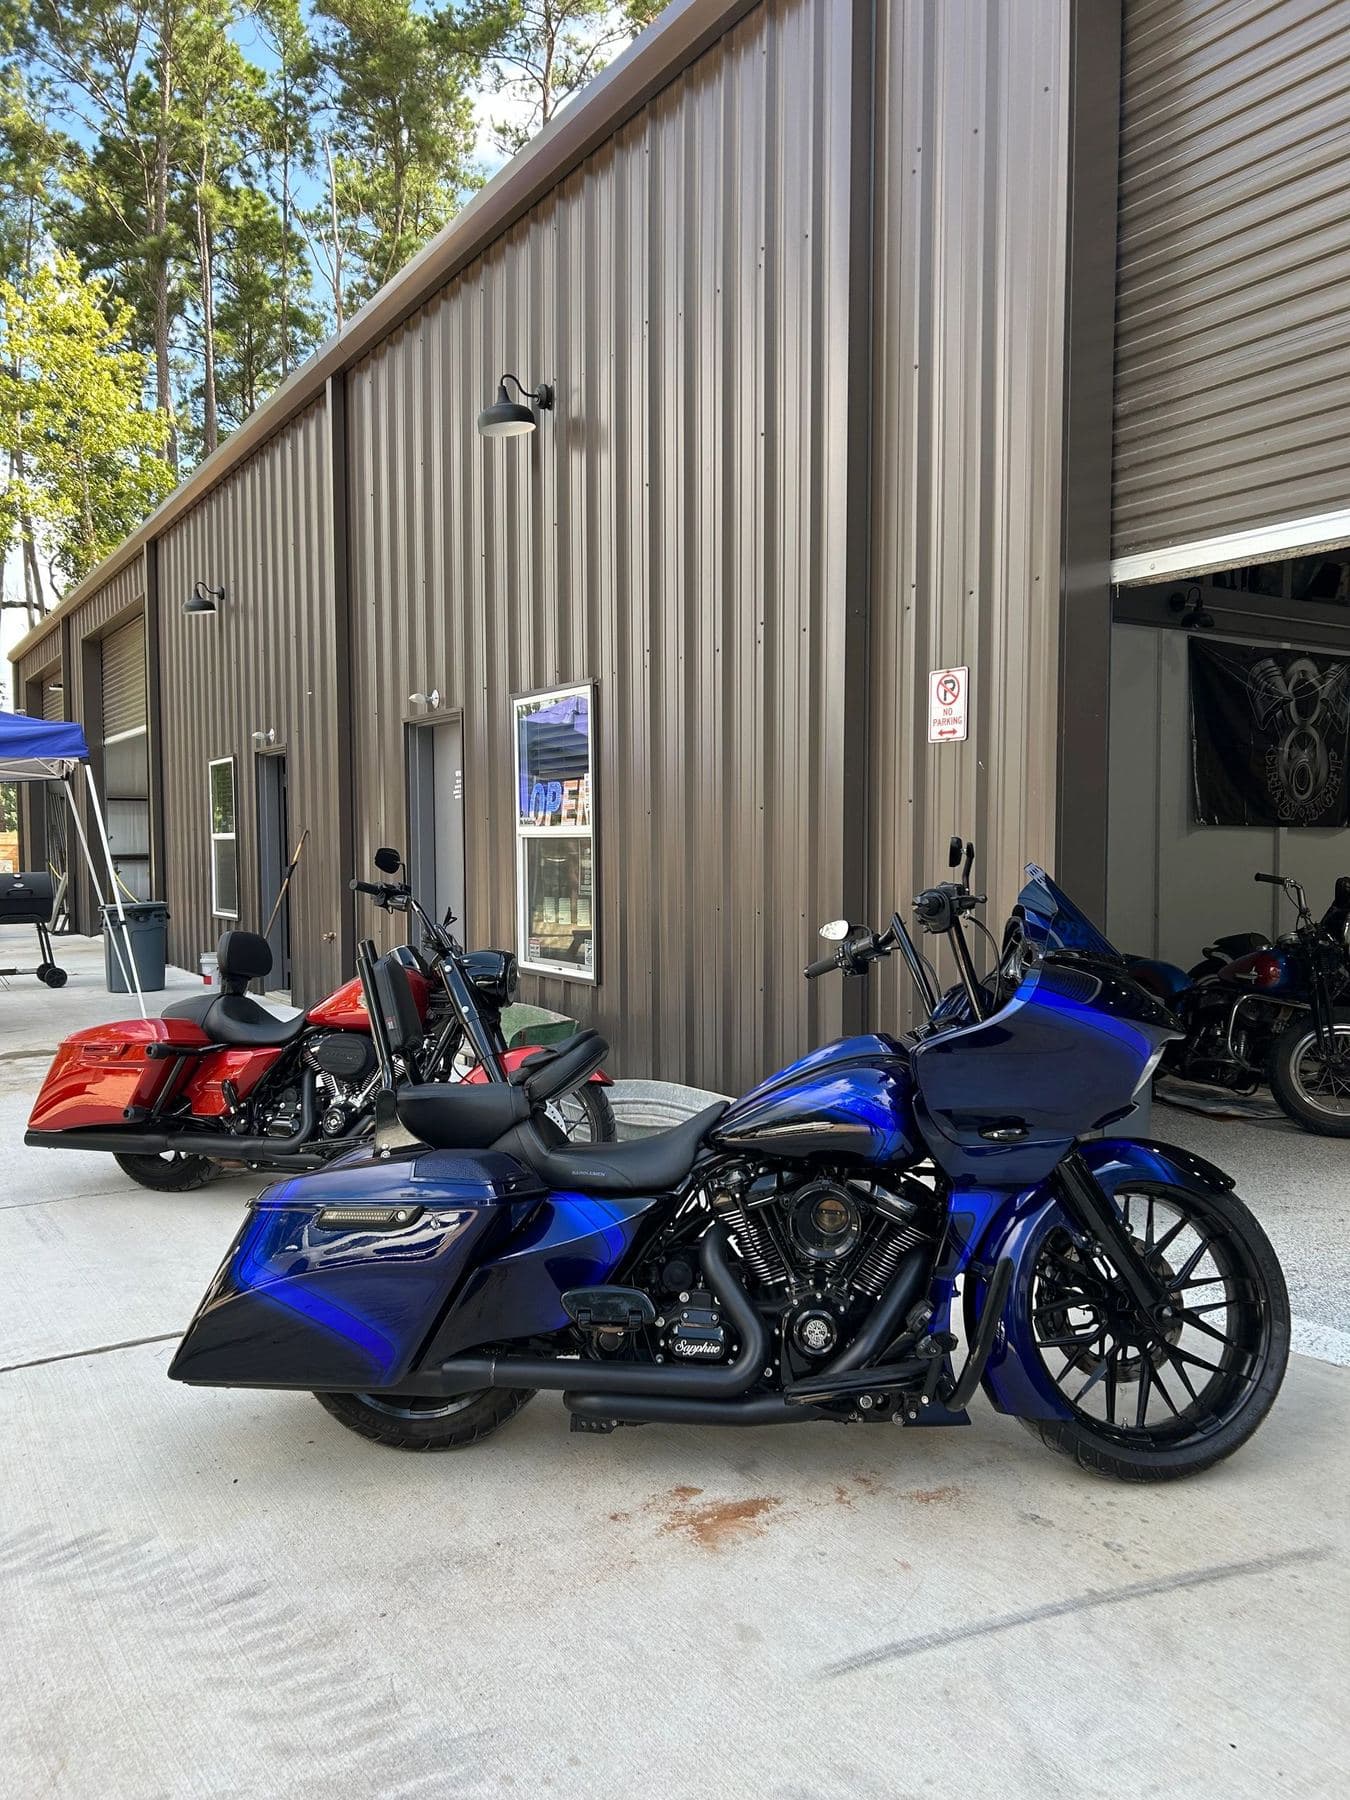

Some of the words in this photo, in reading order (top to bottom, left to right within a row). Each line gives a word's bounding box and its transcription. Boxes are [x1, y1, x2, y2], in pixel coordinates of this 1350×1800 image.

[943, 708, 953, 717] NO
[932, 716, 963, 727] PARKING
[674, 1339, 721, 1357] Sapphire
